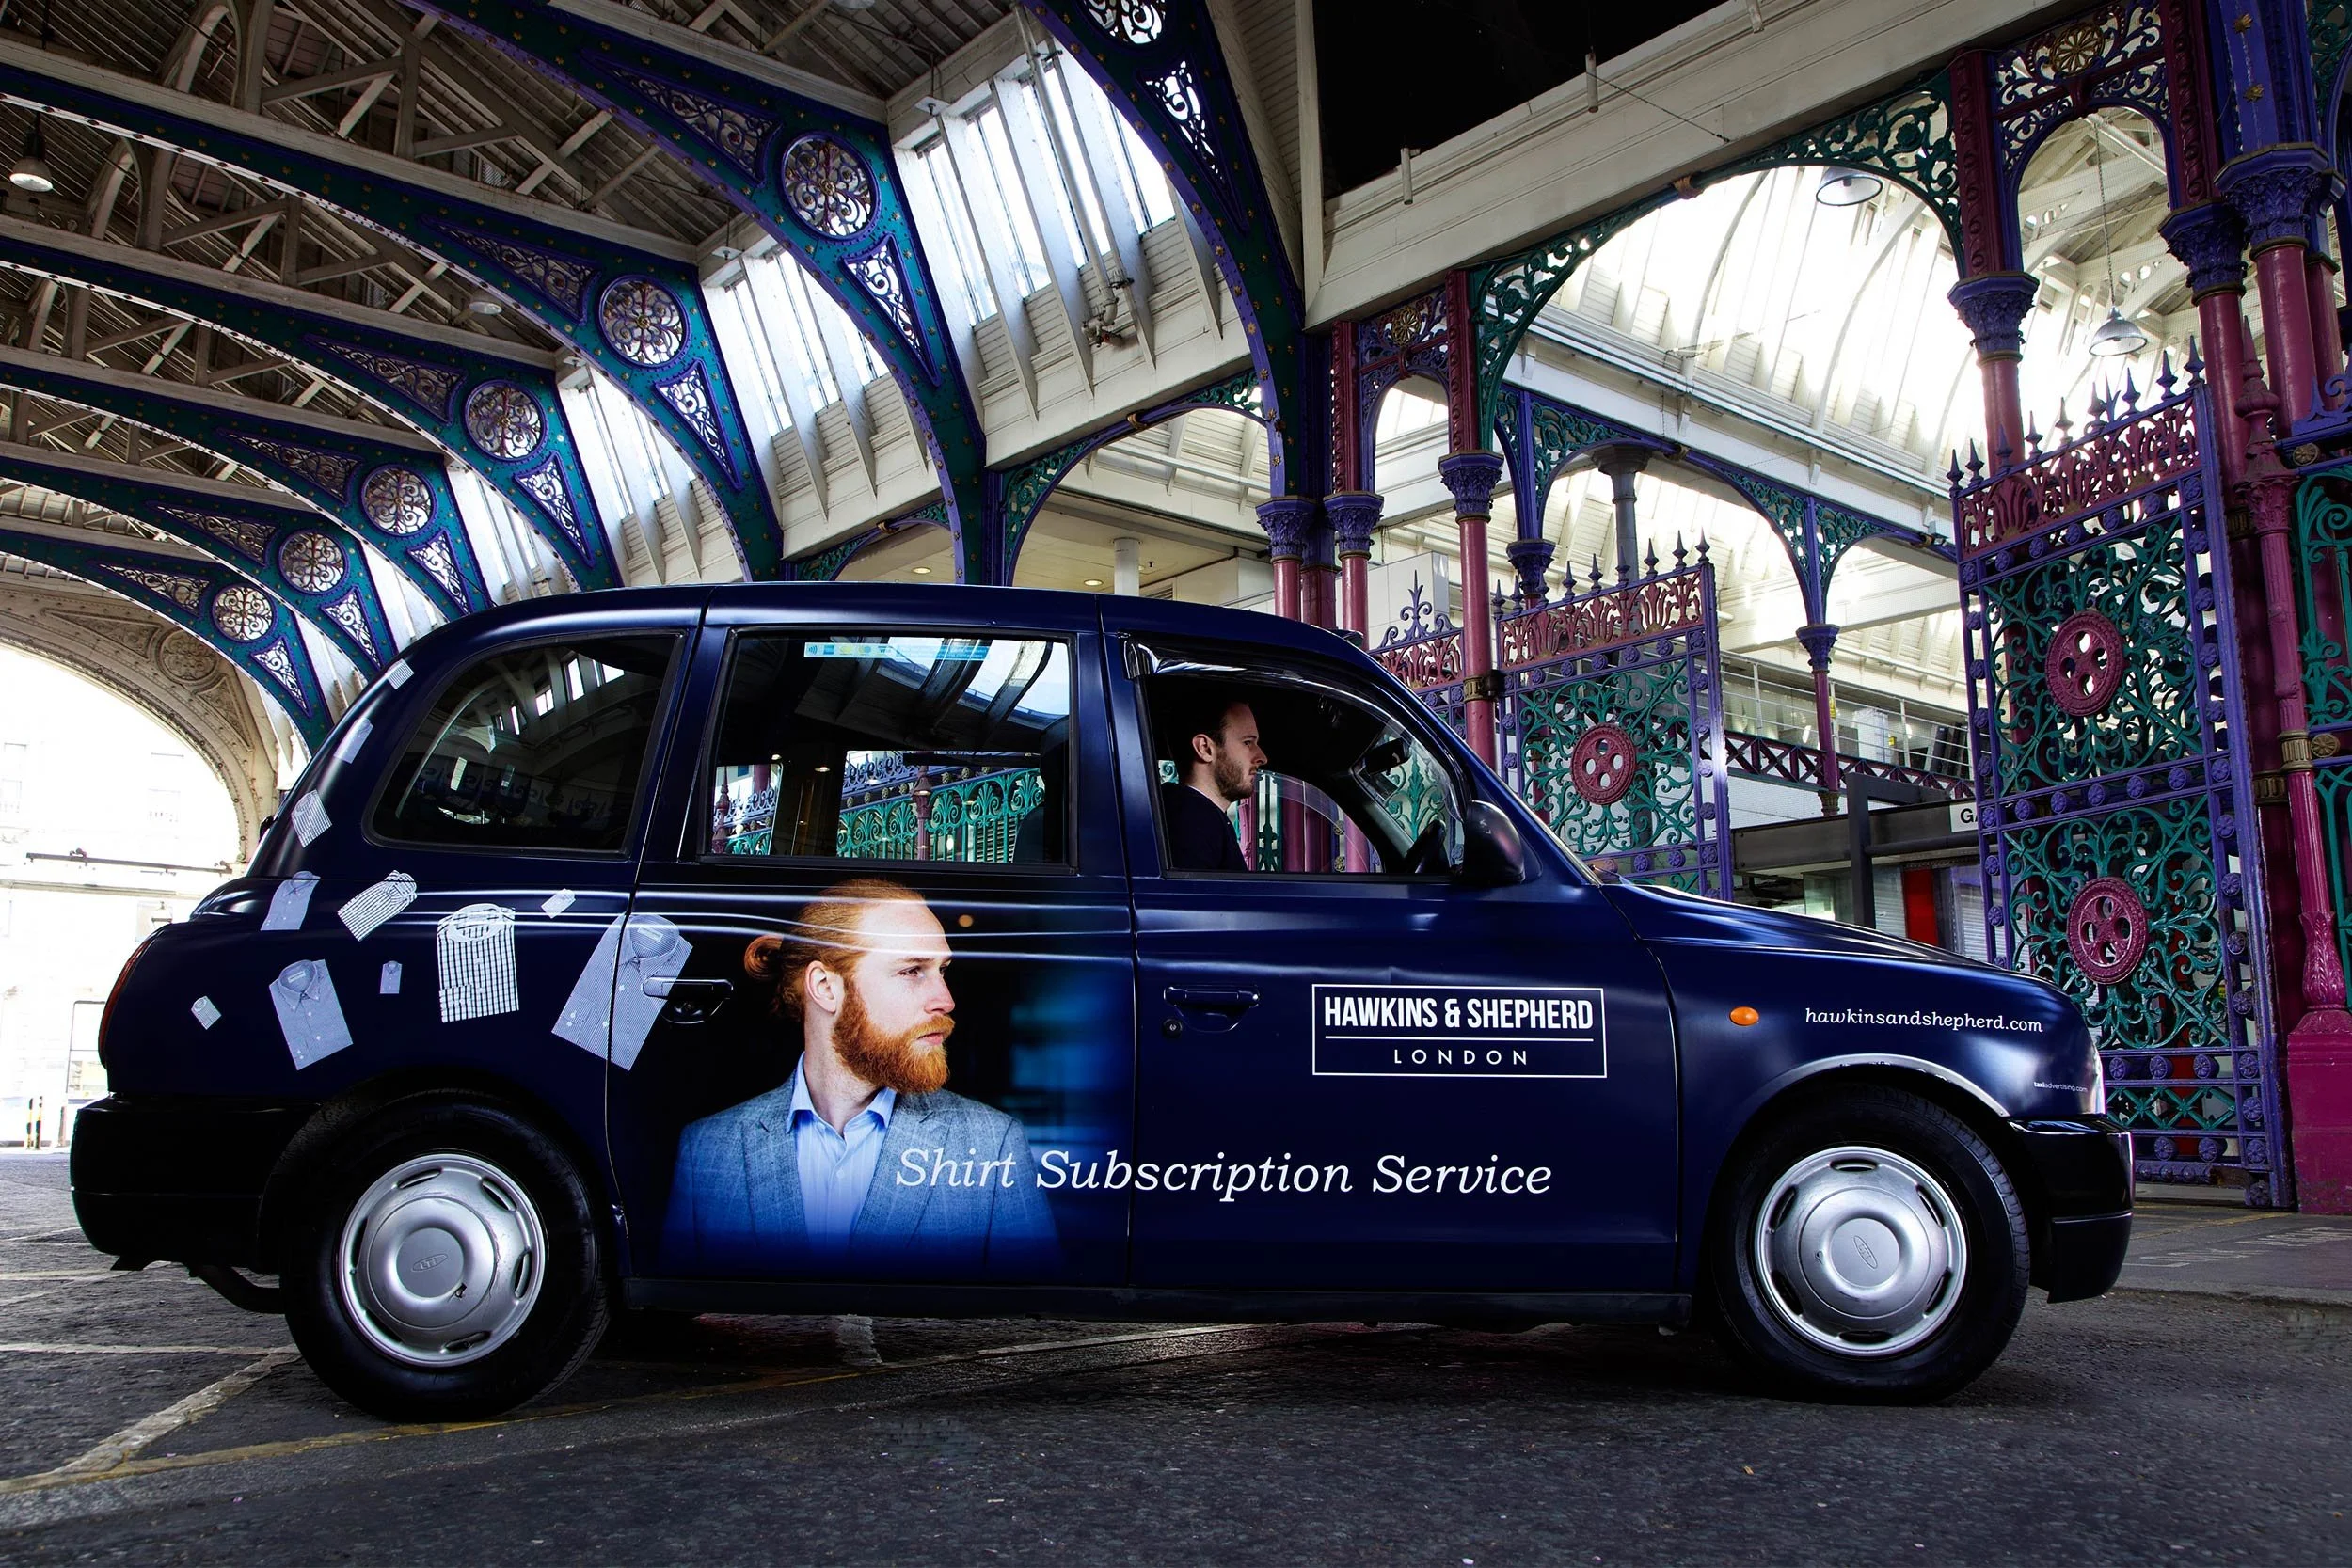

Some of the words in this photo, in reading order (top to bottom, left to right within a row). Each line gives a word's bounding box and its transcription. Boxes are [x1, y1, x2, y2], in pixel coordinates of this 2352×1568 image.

[1960, 808, 1978, 824] G
[1324, 996, 1438, 1028] HAWKINS
[1444, 998, 1461, 1028] &
[1467, 998, 1594, 1029] SHEPHERD
[1804, 1007, 2043, 1033] hawkinsandshepherd.com
[1394, 1049, 1527, 1065] LONDON
[896, 1148, 1017, 1188] Shirt
[1036, 1149, 1353, 1202] Subscription
[1372, 1154, 1552, 1195] Service
